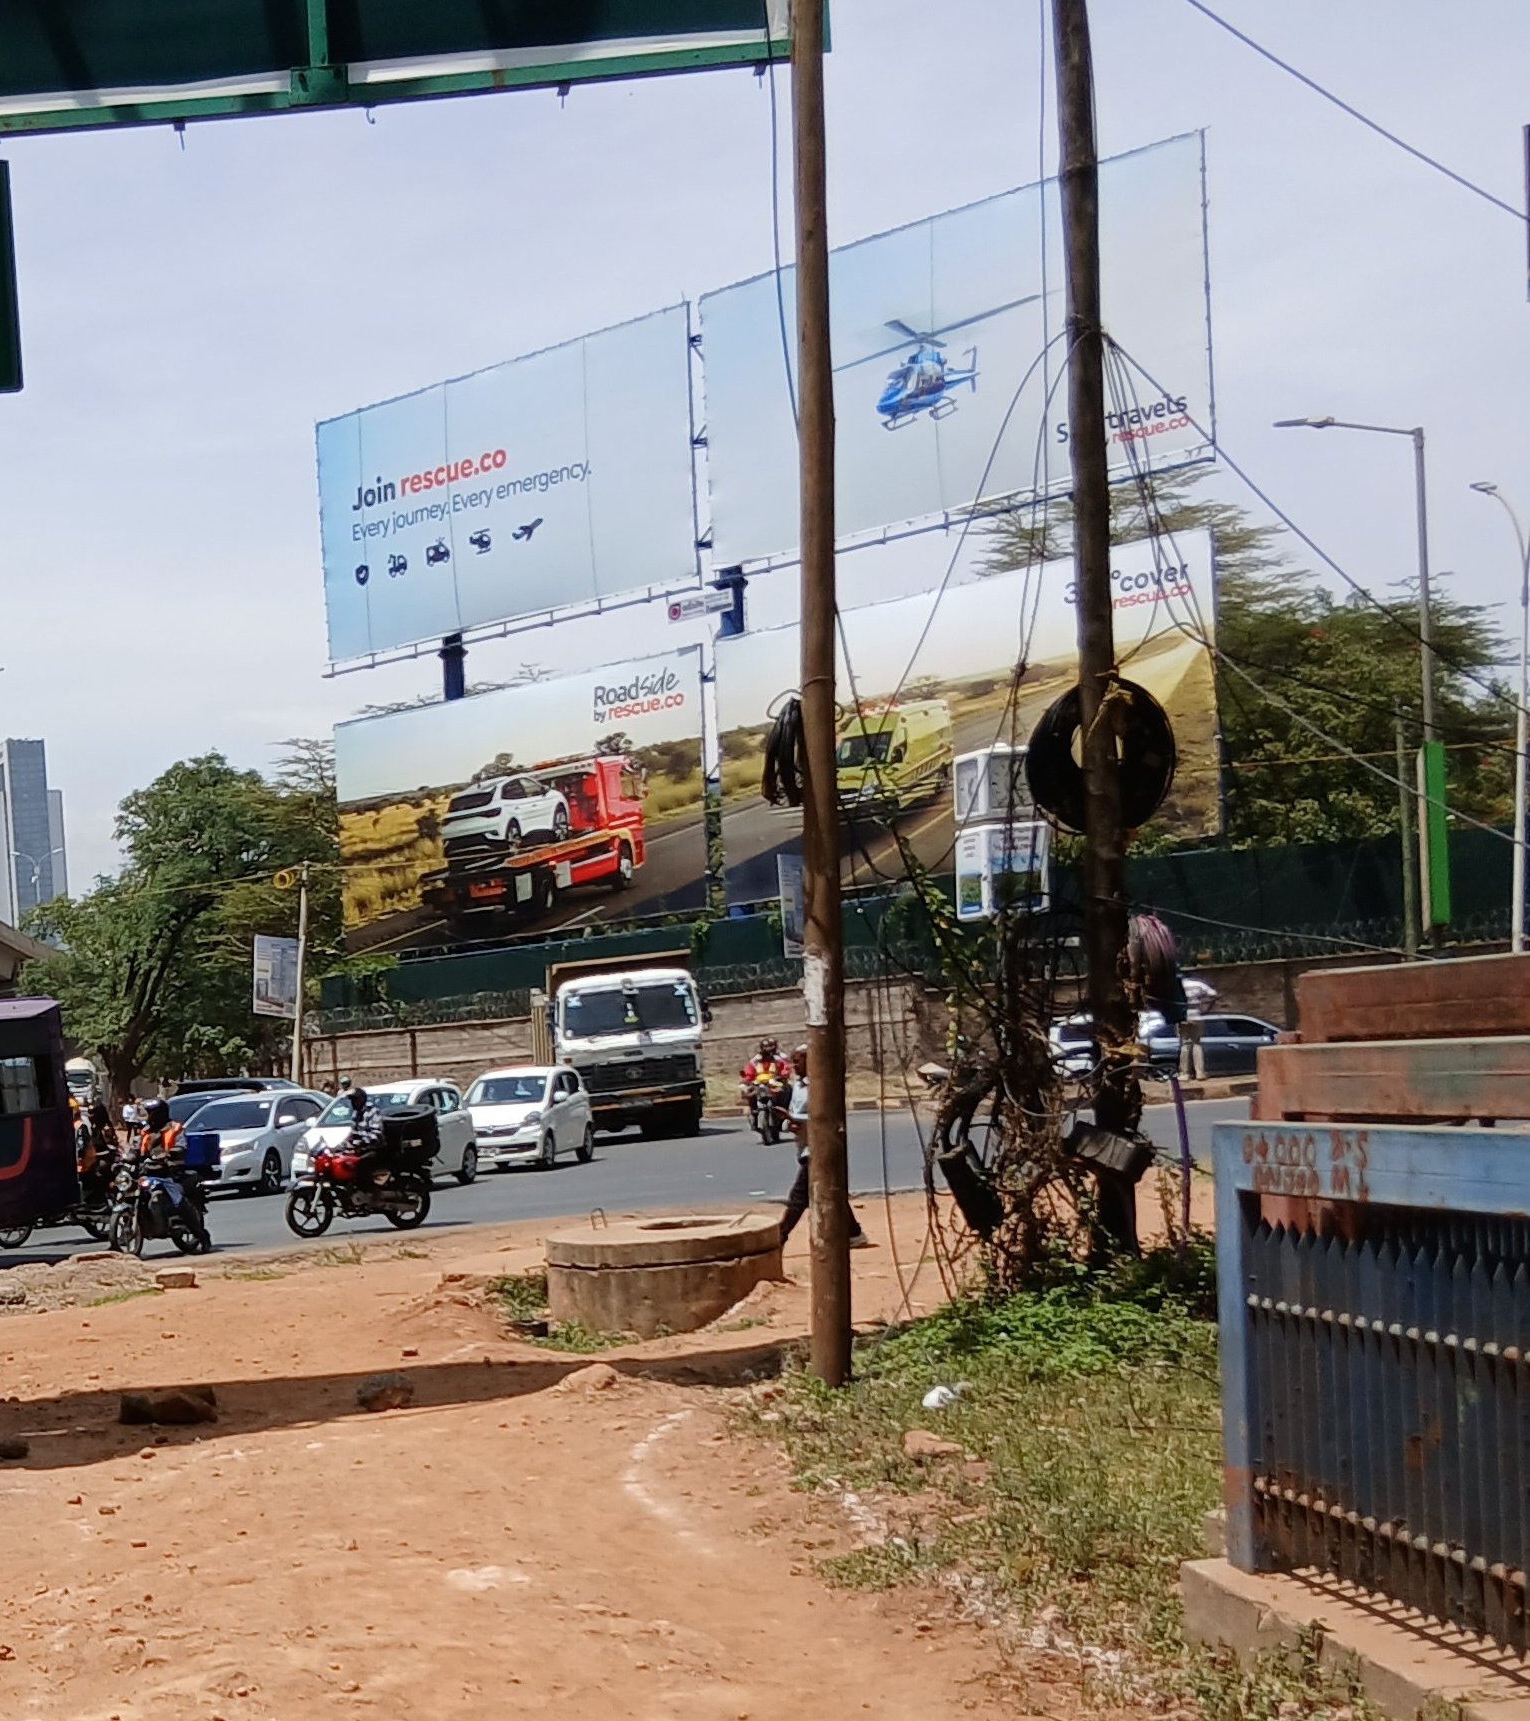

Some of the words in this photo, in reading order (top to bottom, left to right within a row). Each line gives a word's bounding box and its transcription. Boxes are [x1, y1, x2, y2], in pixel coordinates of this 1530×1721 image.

[1113, 416, 1190, 443] rescue.co
[352, 475, 396, 511] Join
[400, 446, 506, 497] rescue.co
[352, 513, 390, 542] Every
[392, 500, 449, 534] journey.
[453, 486, 493, 514] Every
[495, 459, 591, 501] emergency.
[1113, 584, 1192, 608] rescue.co
[594, 667, 679, 707] Roadside
[593, 709, 607, 723] by
[608, 693, 684, 720] rescue.co
